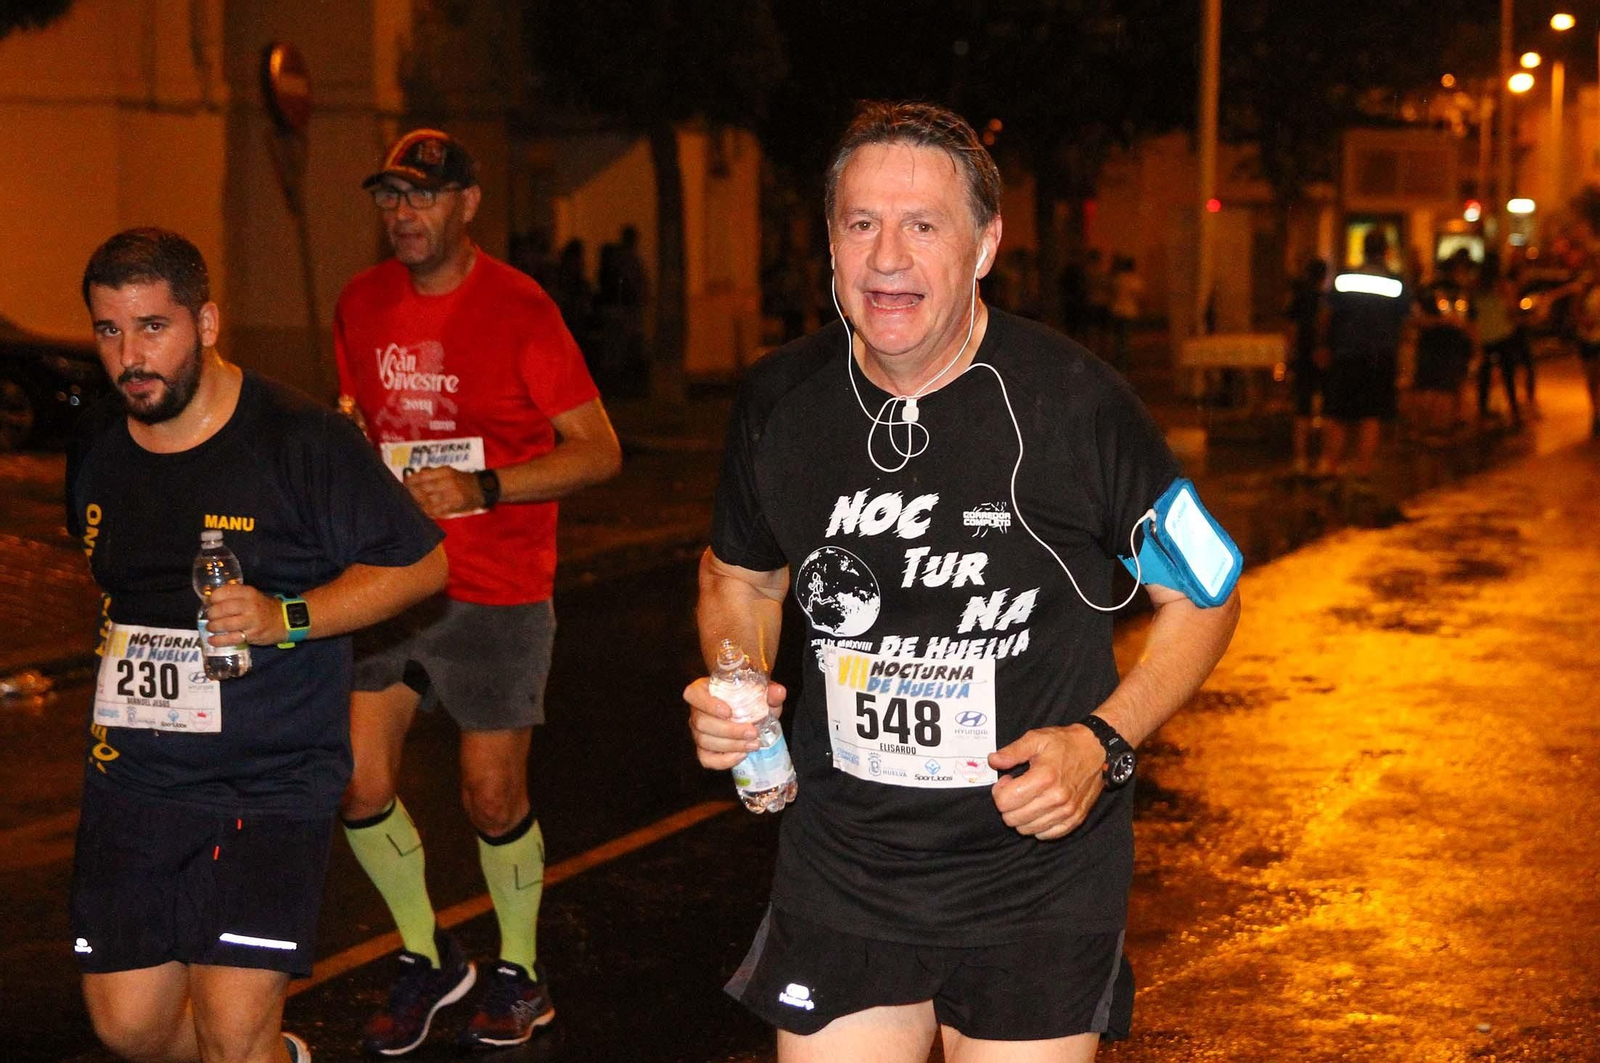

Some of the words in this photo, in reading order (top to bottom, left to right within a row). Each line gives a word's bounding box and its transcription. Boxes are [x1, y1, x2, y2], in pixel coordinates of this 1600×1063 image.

[204, 514, 255, 532] MANU
[825, 487, 940, 539] NOC
[963, 511, 1011, 520] CORREDOR
[901, 546, 988, 588] TUR
[957, 587, 1040, 635] NA
[126, 646, 145, 659] DE
[147, 648, 199, 662] HUELVA
[128, 633, 201, 649] NOCTURNA
[878, 635, 919, 658] DE
[926, 628, 1030, 660] HUELVA
[117, 659, 179, 700] 230
[838, 654, 870, 691] VII
[870, 660, 975, 681] NOCTURNA
[866, 677, 892, 693] DE
[895, 681, 971, 699] HUELVA
[856, 691, 942, 747] 548
[880, 743, 917, 755] ELISARDO
[882, 769, 907, 777] HUELVA
